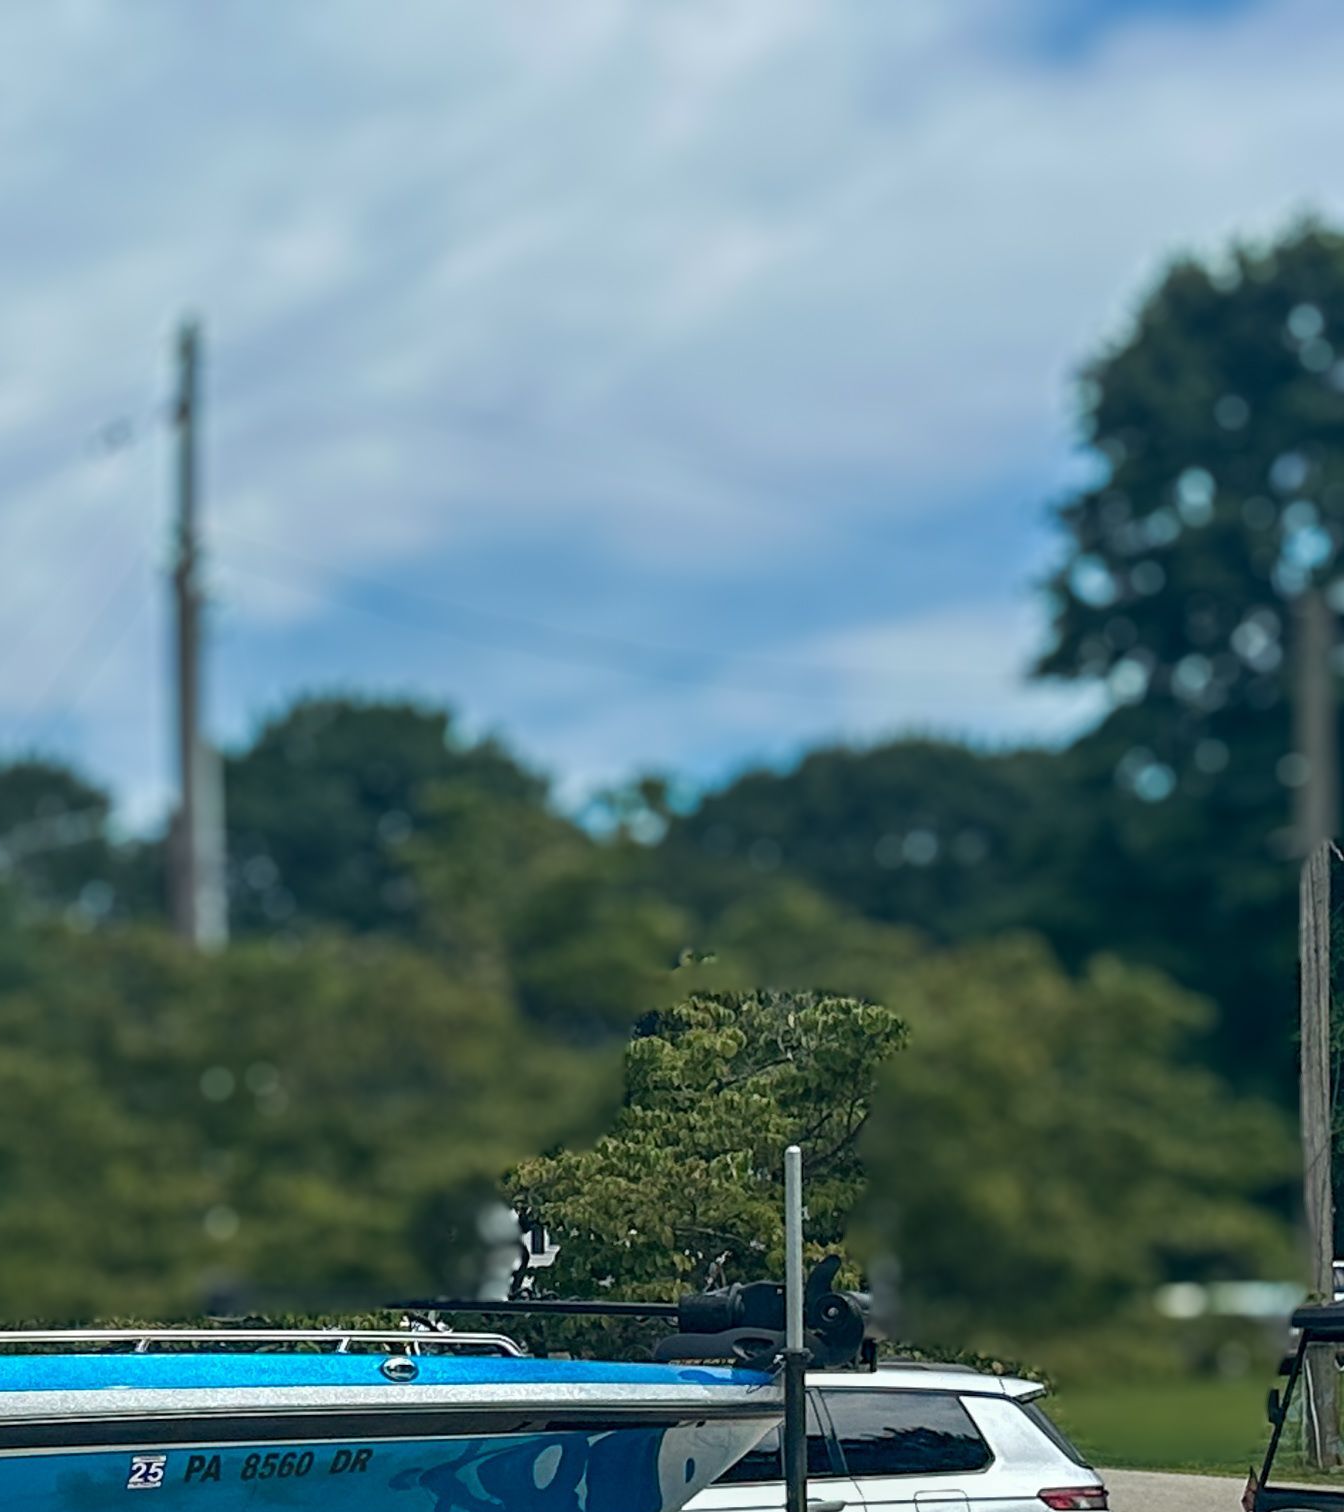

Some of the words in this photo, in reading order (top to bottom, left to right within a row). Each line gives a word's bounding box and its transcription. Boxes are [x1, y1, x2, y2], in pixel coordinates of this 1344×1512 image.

[128, 1462, 165, 1483] 25
[184, 1455, 221, 1482] PA
[240, 1451, 315, 1481] 8560
[328, 1449, 373, 1475] DR
